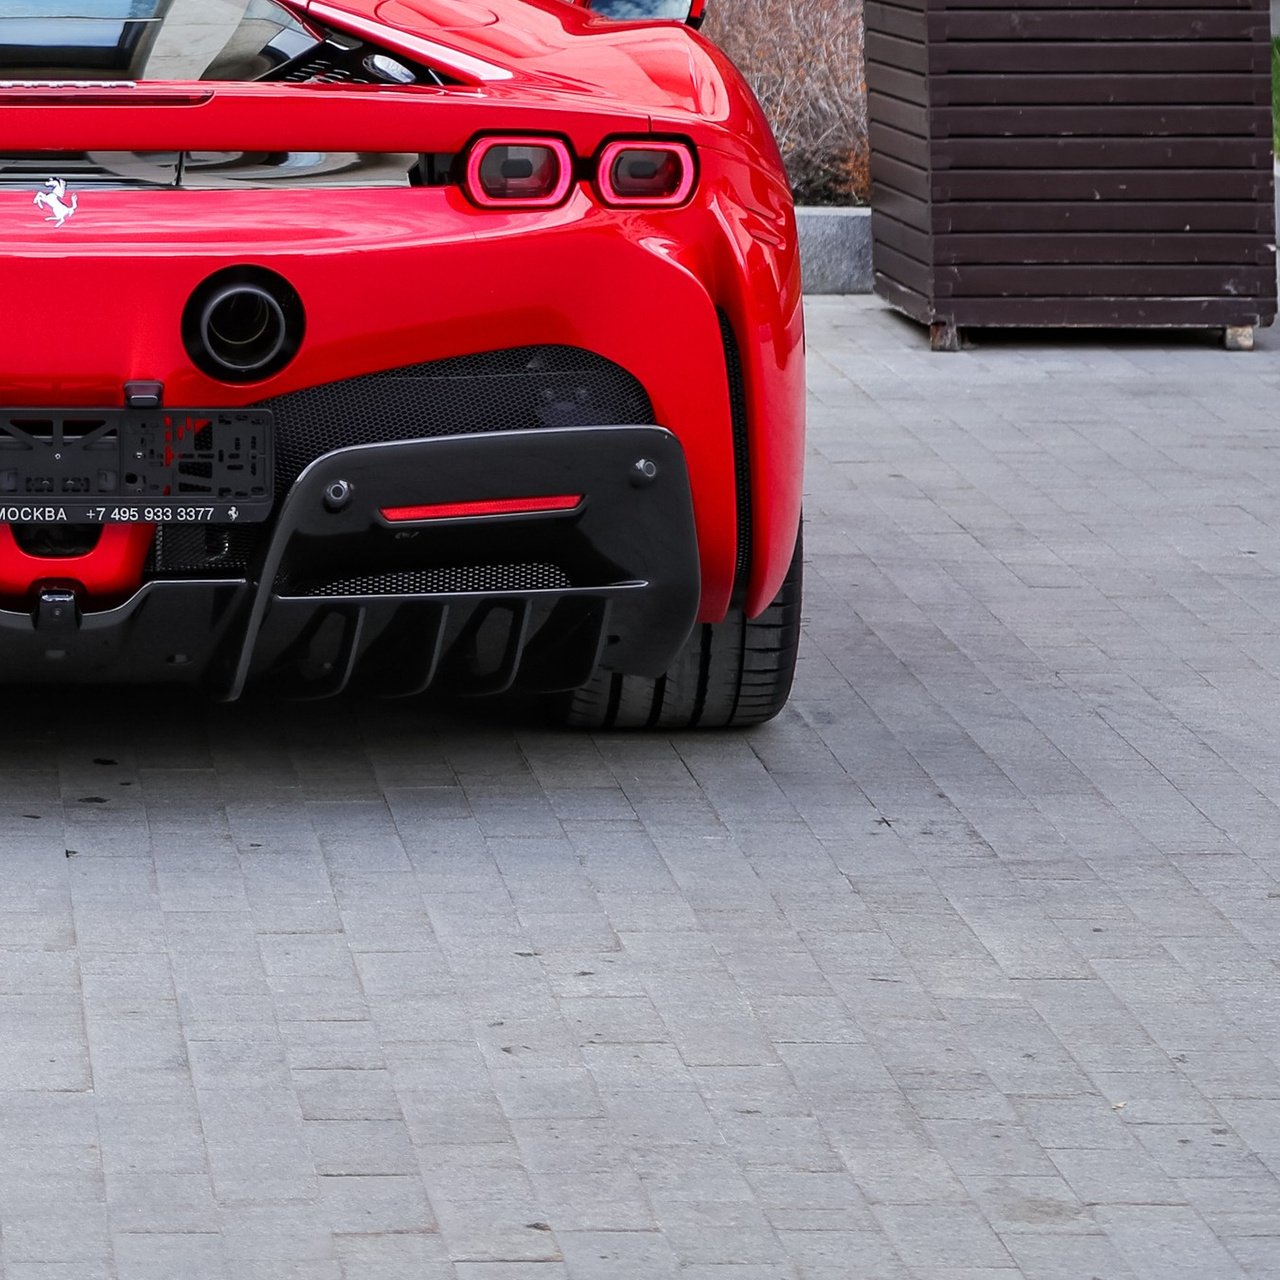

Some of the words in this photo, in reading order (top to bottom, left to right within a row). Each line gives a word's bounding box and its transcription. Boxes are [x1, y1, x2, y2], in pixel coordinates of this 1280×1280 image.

[86, 507, 106, 521] +7
[110, 507, 139, 521] 495
[144, 507, 173, 521] 933
[176, 507, 215, 521] 3377
